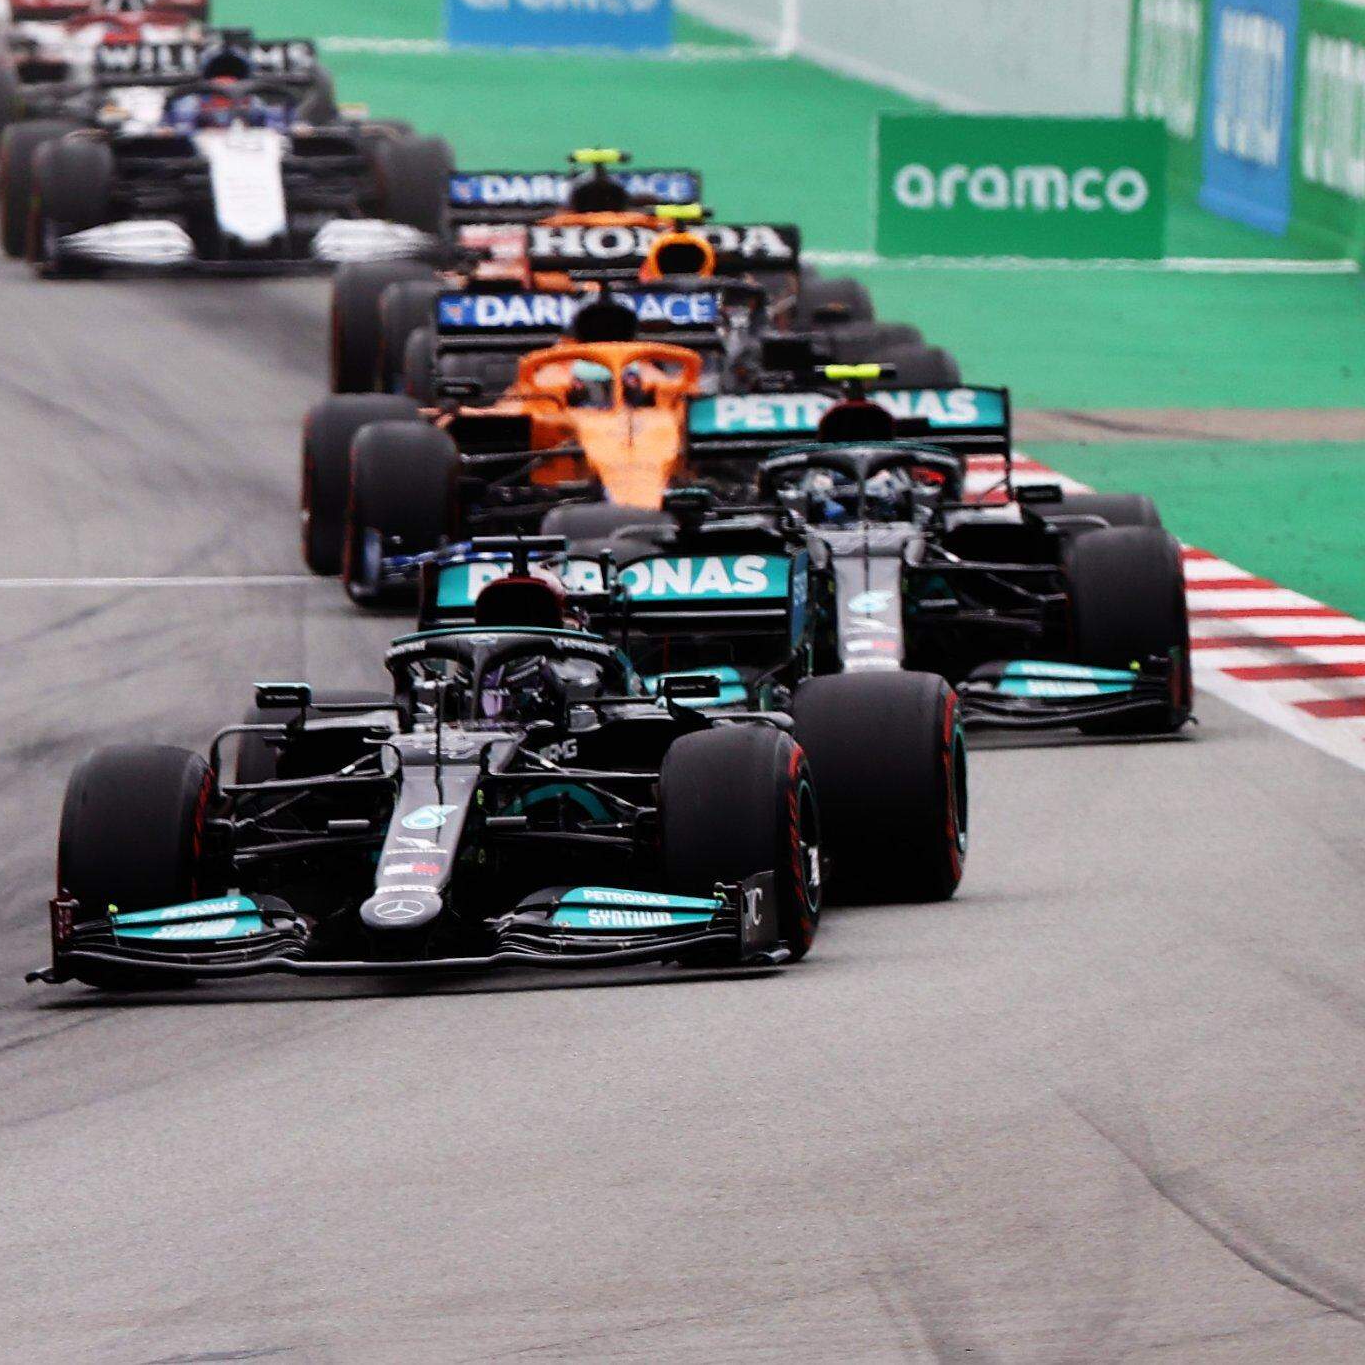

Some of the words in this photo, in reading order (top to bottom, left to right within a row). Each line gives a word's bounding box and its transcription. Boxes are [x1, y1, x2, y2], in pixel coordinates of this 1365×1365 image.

[894, 165, 1149, 212] aramco
[716, 388, 977, 429] PETRNAS
[582, 890, 669, 904] PETRONAS
